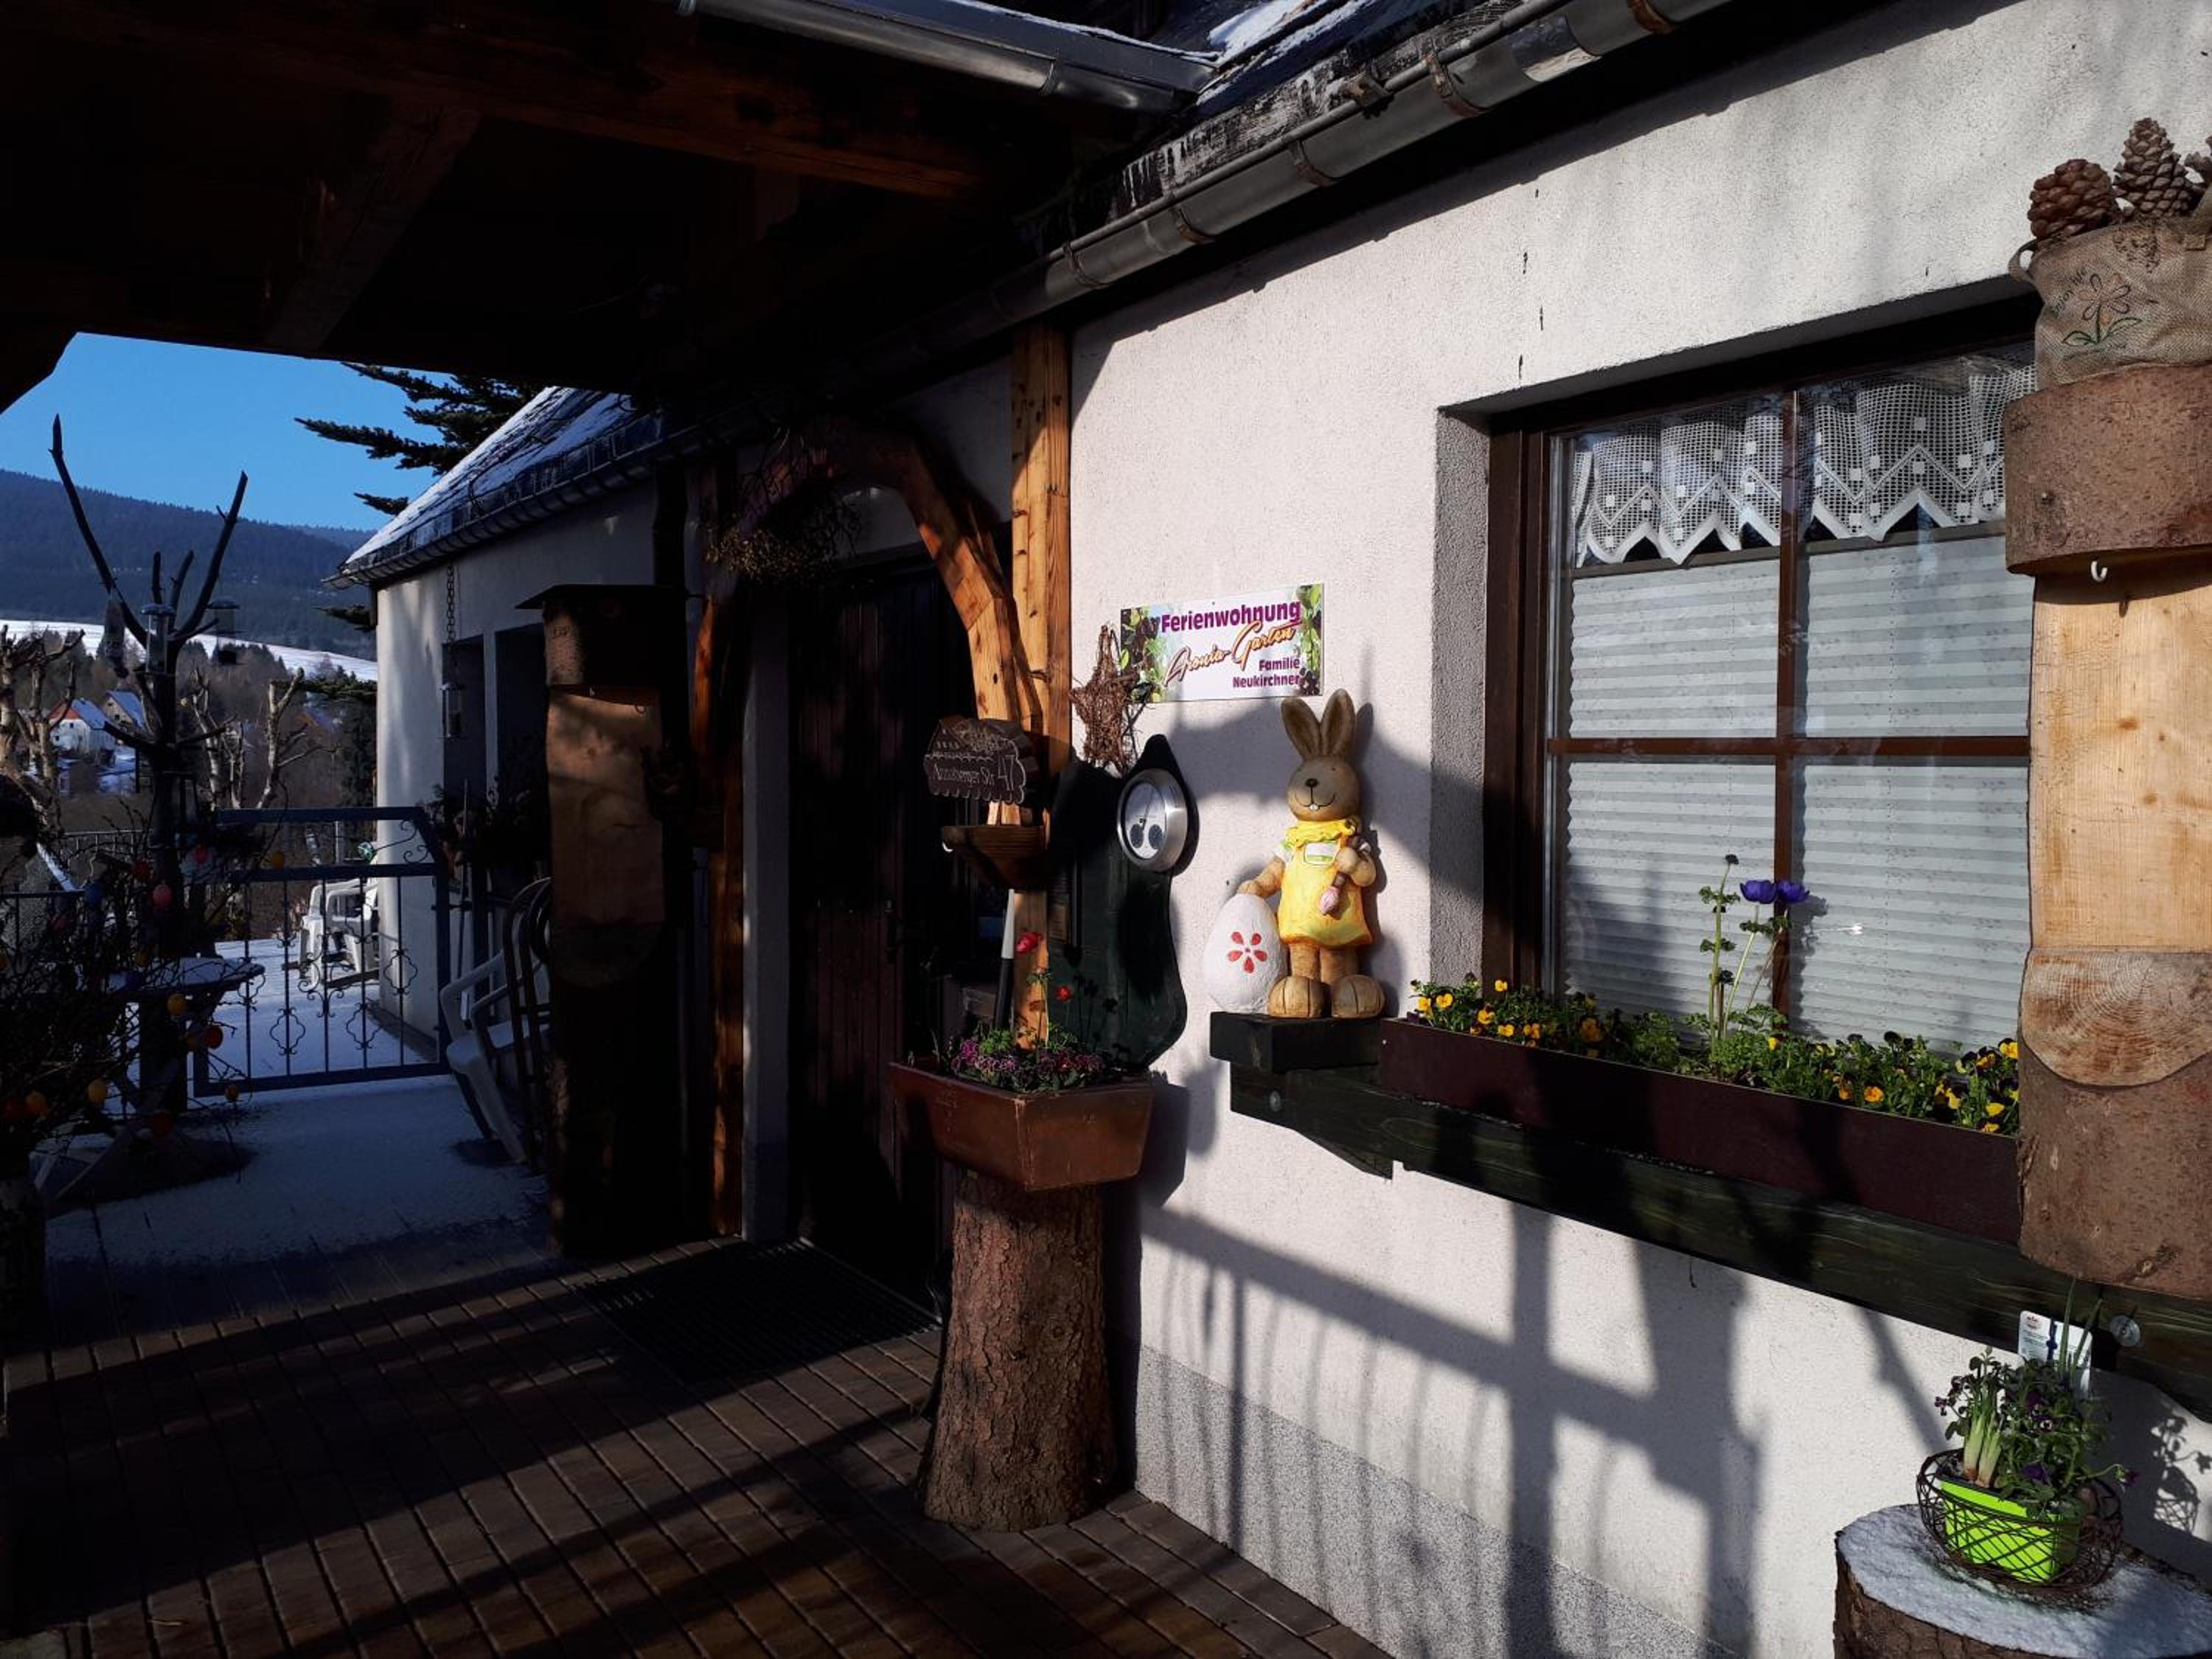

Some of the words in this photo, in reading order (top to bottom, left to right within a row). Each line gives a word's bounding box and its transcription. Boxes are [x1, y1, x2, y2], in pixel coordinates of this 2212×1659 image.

[1161, 602, 1301, 633] Ferienwohnung
[1259, 658, 1300, 672] Familie
[1233, 674, 1300, 688] Neukirchner
[998, 754, 1015, 790] 47
